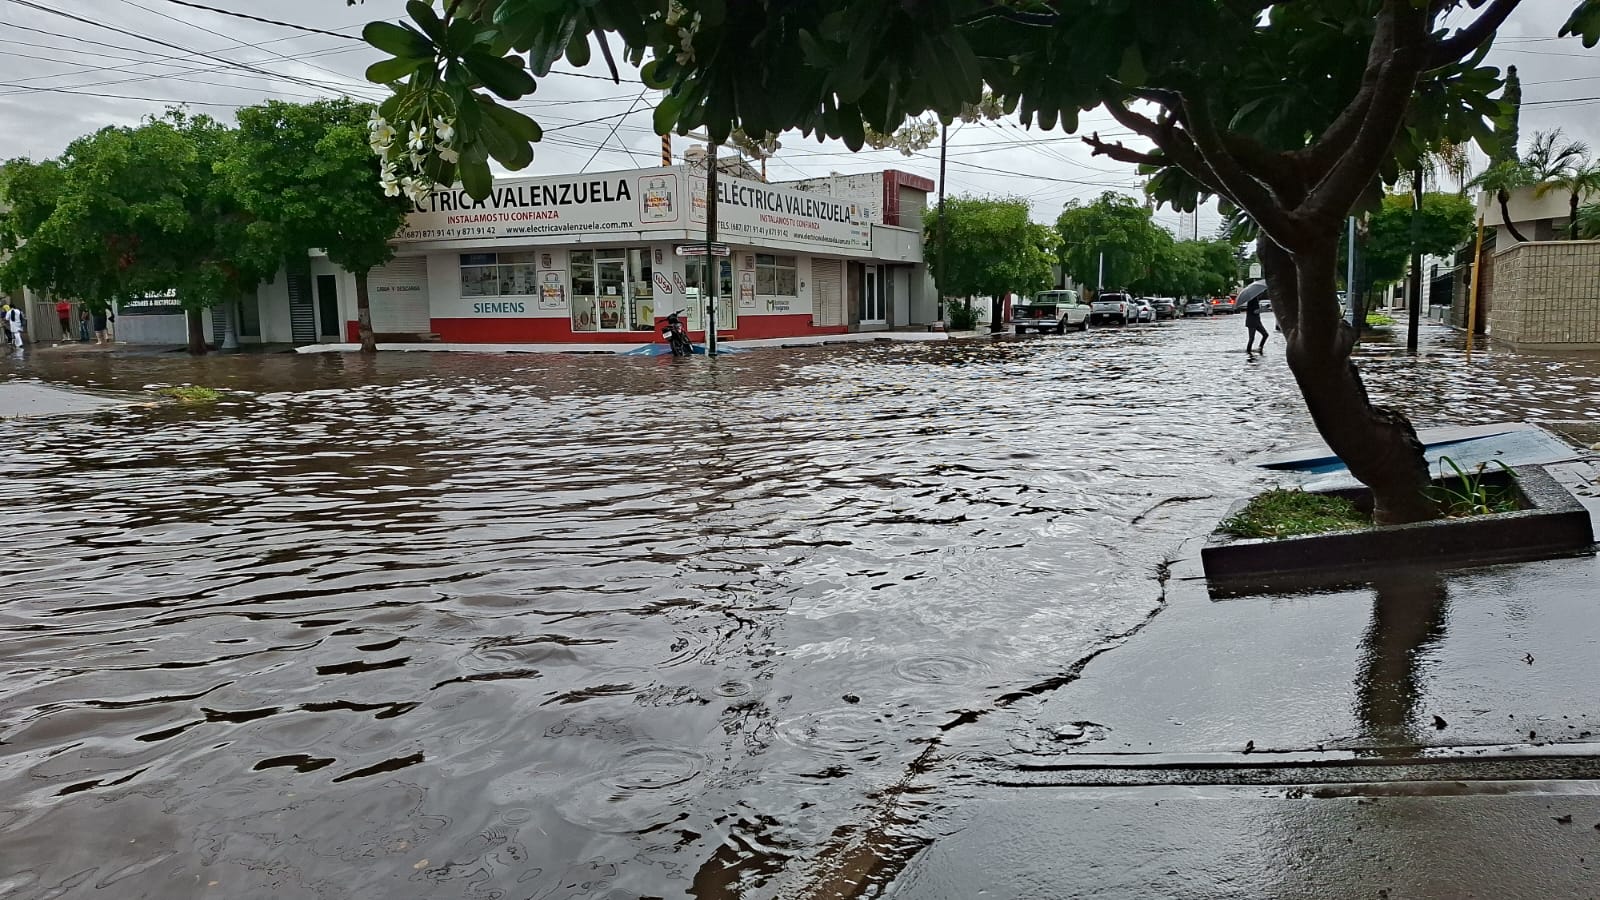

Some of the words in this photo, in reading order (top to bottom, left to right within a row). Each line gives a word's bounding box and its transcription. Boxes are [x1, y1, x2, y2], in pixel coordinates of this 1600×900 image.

[490, 179, 632, 209] VALENZUELA
[717, 181, 784, 213] ELÉCTRICA
[784, 195, 850, 224] VALENZUELA
[447, 212, 497, 225] INSTALAMOS
[499, 213, 509, 222] TU
[511, 210, 559, 221] CONFIANZA
[759, 213, 789, 226] INSTALAMOS
[404, 230, 422, 239] (687)
[422, 230, 435, 238] 871
[436, 229, 445, 237] 91
[446, 228, 455, 237] 41
[456, 229, 461, 237] y
[462, 227, 475, 236] 871
[476, 227, 485, 235] 91
[487, 226, 496, 235] 42
[505, 220, 633, 233] www.electricavalenzuela.com.mx
[655, 274, 671, 292] IUSA
[473, 302, 525, 313] SIEMENS
